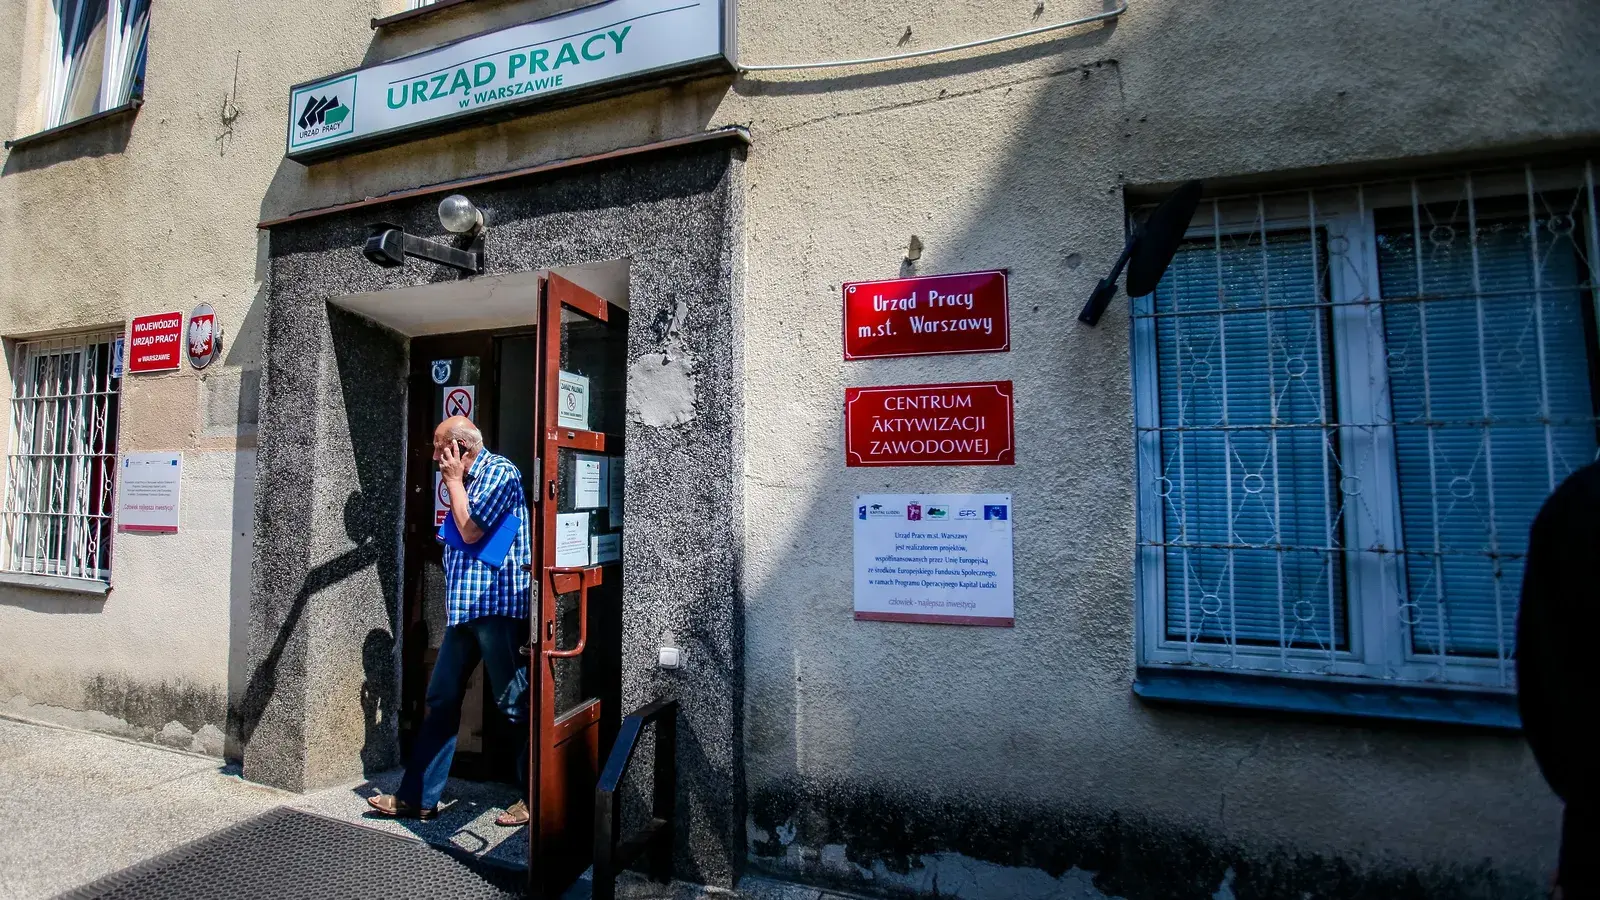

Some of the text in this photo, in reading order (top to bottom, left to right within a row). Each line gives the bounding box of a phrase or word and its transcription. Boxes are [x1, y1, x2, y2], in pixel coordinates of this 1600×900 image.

[387, 25, 632, 110] URZĄD PRACY
[458, 74, 563, 109] w WARSZAWIE
[322, 122, 341, 133] PRACY
[873, 290, 973, 312] Urząd Pracy
[134, 319, 179, 333] WOJEWÓDZKI
[858, 315, 993, 338] m.st. Warszawy
[132, 333, 179, 347] URZĄD PRACY
[142, 353, 171, 363] WARSZAWIE
[884, 394, 972, 411] CENTRUM
[870, 439, 989, 456] ZAWODOWEJ
[958, 509, 977, 517] EFS
[911, 532, 926, 541] Pracy
[940, 532, 968, 542] Warszawy
[895, 543, 905, 552] jest
[905, 543, 939, 551] realizatorem
[929, 557, 943, 565] przez
[897, 567, 934, 577] Europejskiego
[934, 568, 961, 576] Funduszu
[874, 578, 894, 586] ramach
[894, 579, 920, 588] Programu
[921, 580, 958, 589] Operacyjnego
[979, 581, 997, 589] Ludzki
[918, 599, 945, 609] najlepsza
[945, 600, 977, 611] inwestycja
